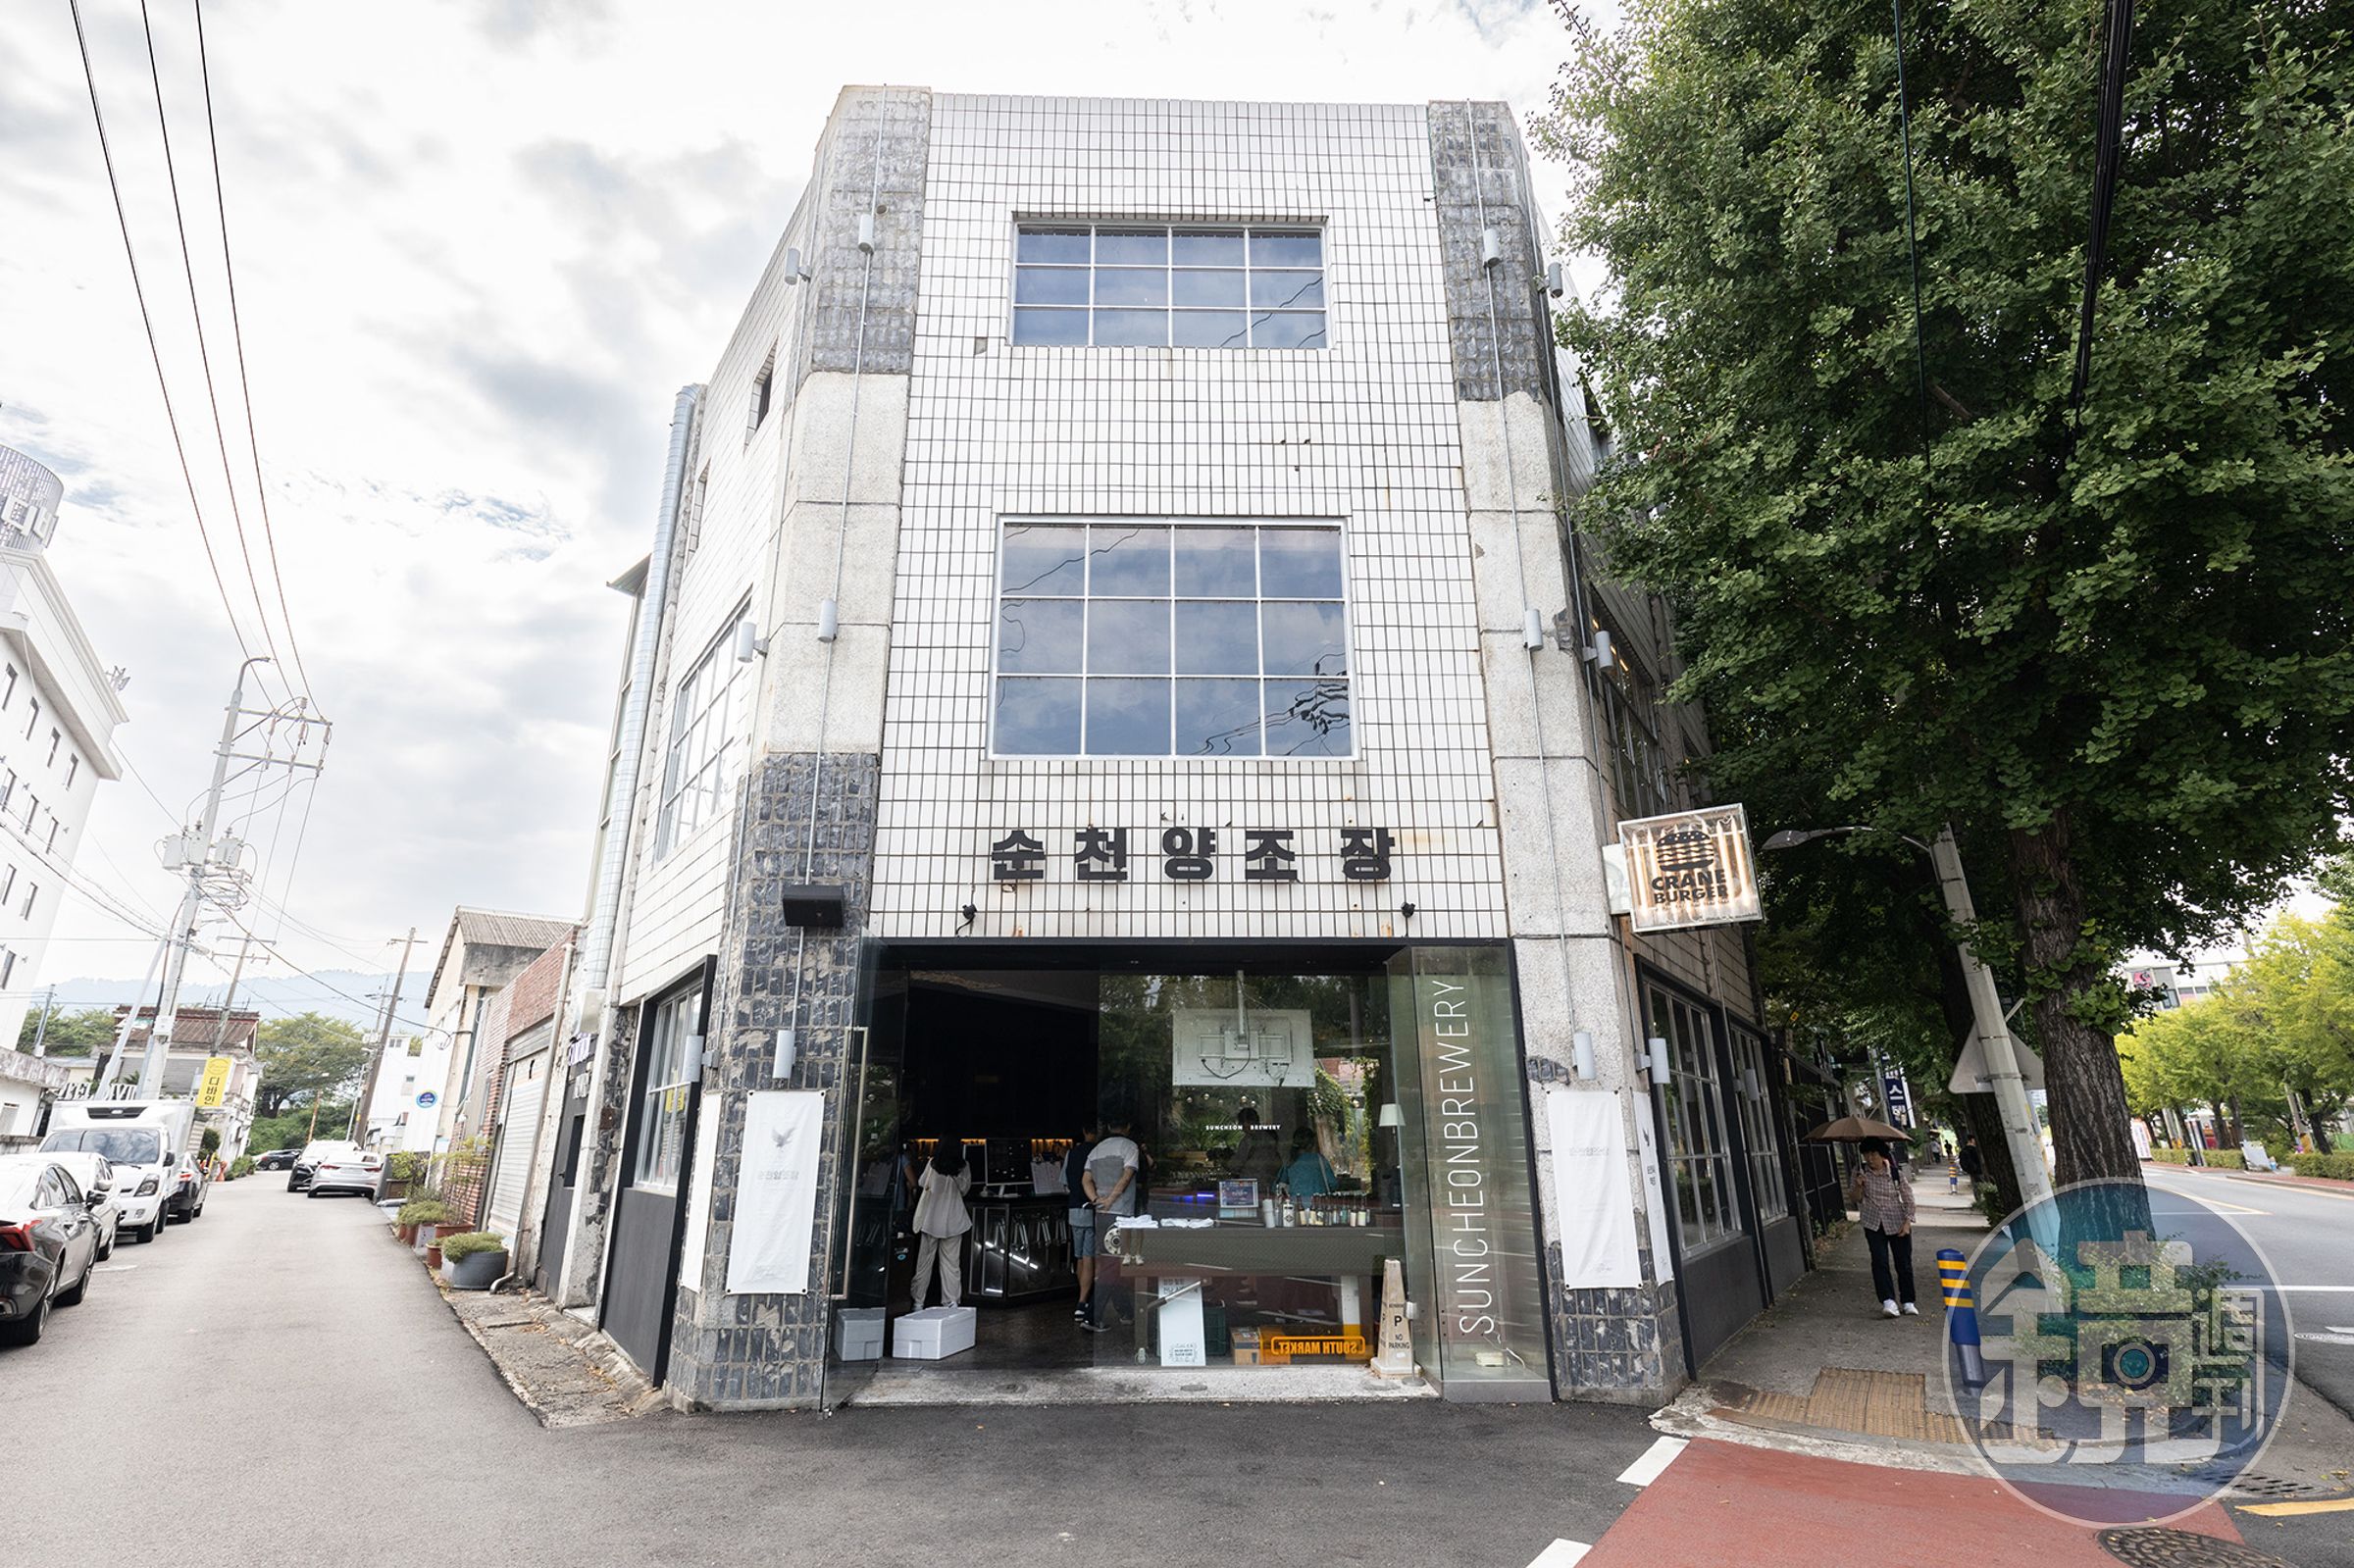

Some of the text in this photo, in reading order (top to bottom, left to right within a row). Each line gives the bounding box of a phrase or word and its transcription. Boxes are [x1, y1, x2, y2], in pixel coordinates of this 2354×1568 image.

[992, 827, 1395, 881] 순천양조장
[1652, 869, 1726, 890] CRANE
[1654, 885, 1729, 904] BURGER
[1432, 981, 1495, 1335] SUNCHEONBREWERY
[1394, 1315, 1403, 1327] P
[1395, 1333, 1404, 1341] NO
